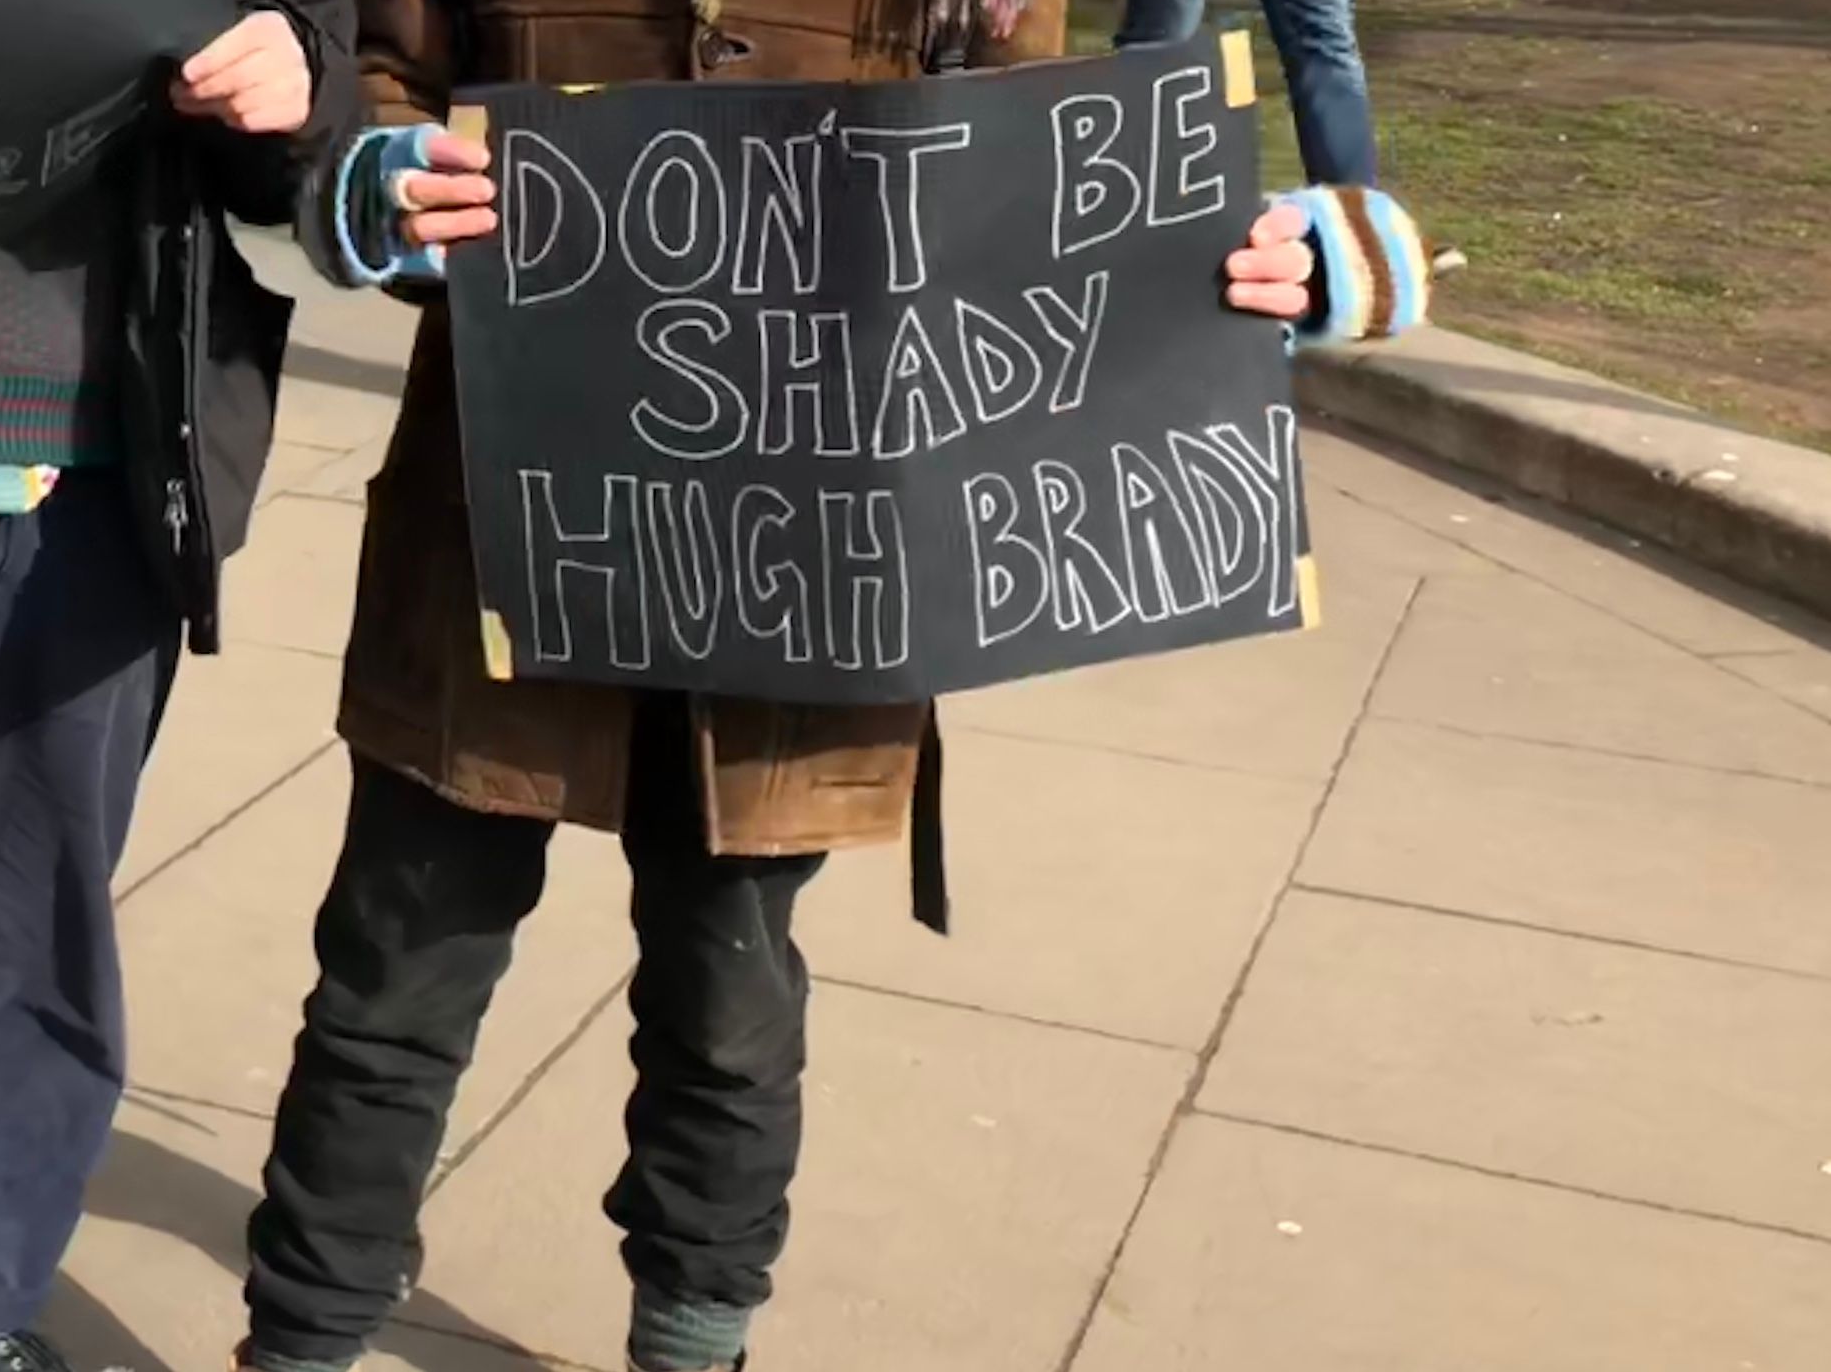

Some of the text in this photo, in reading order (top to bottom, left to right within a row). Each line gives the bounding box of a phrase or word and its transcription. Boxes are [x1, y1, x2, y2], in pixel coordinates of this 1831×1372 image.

[501, 65, 1225, 307] DON'T BE
[630, 271, 1110, 461] SHADY
[519, 406, 1299, 671] HUGH BRADY
